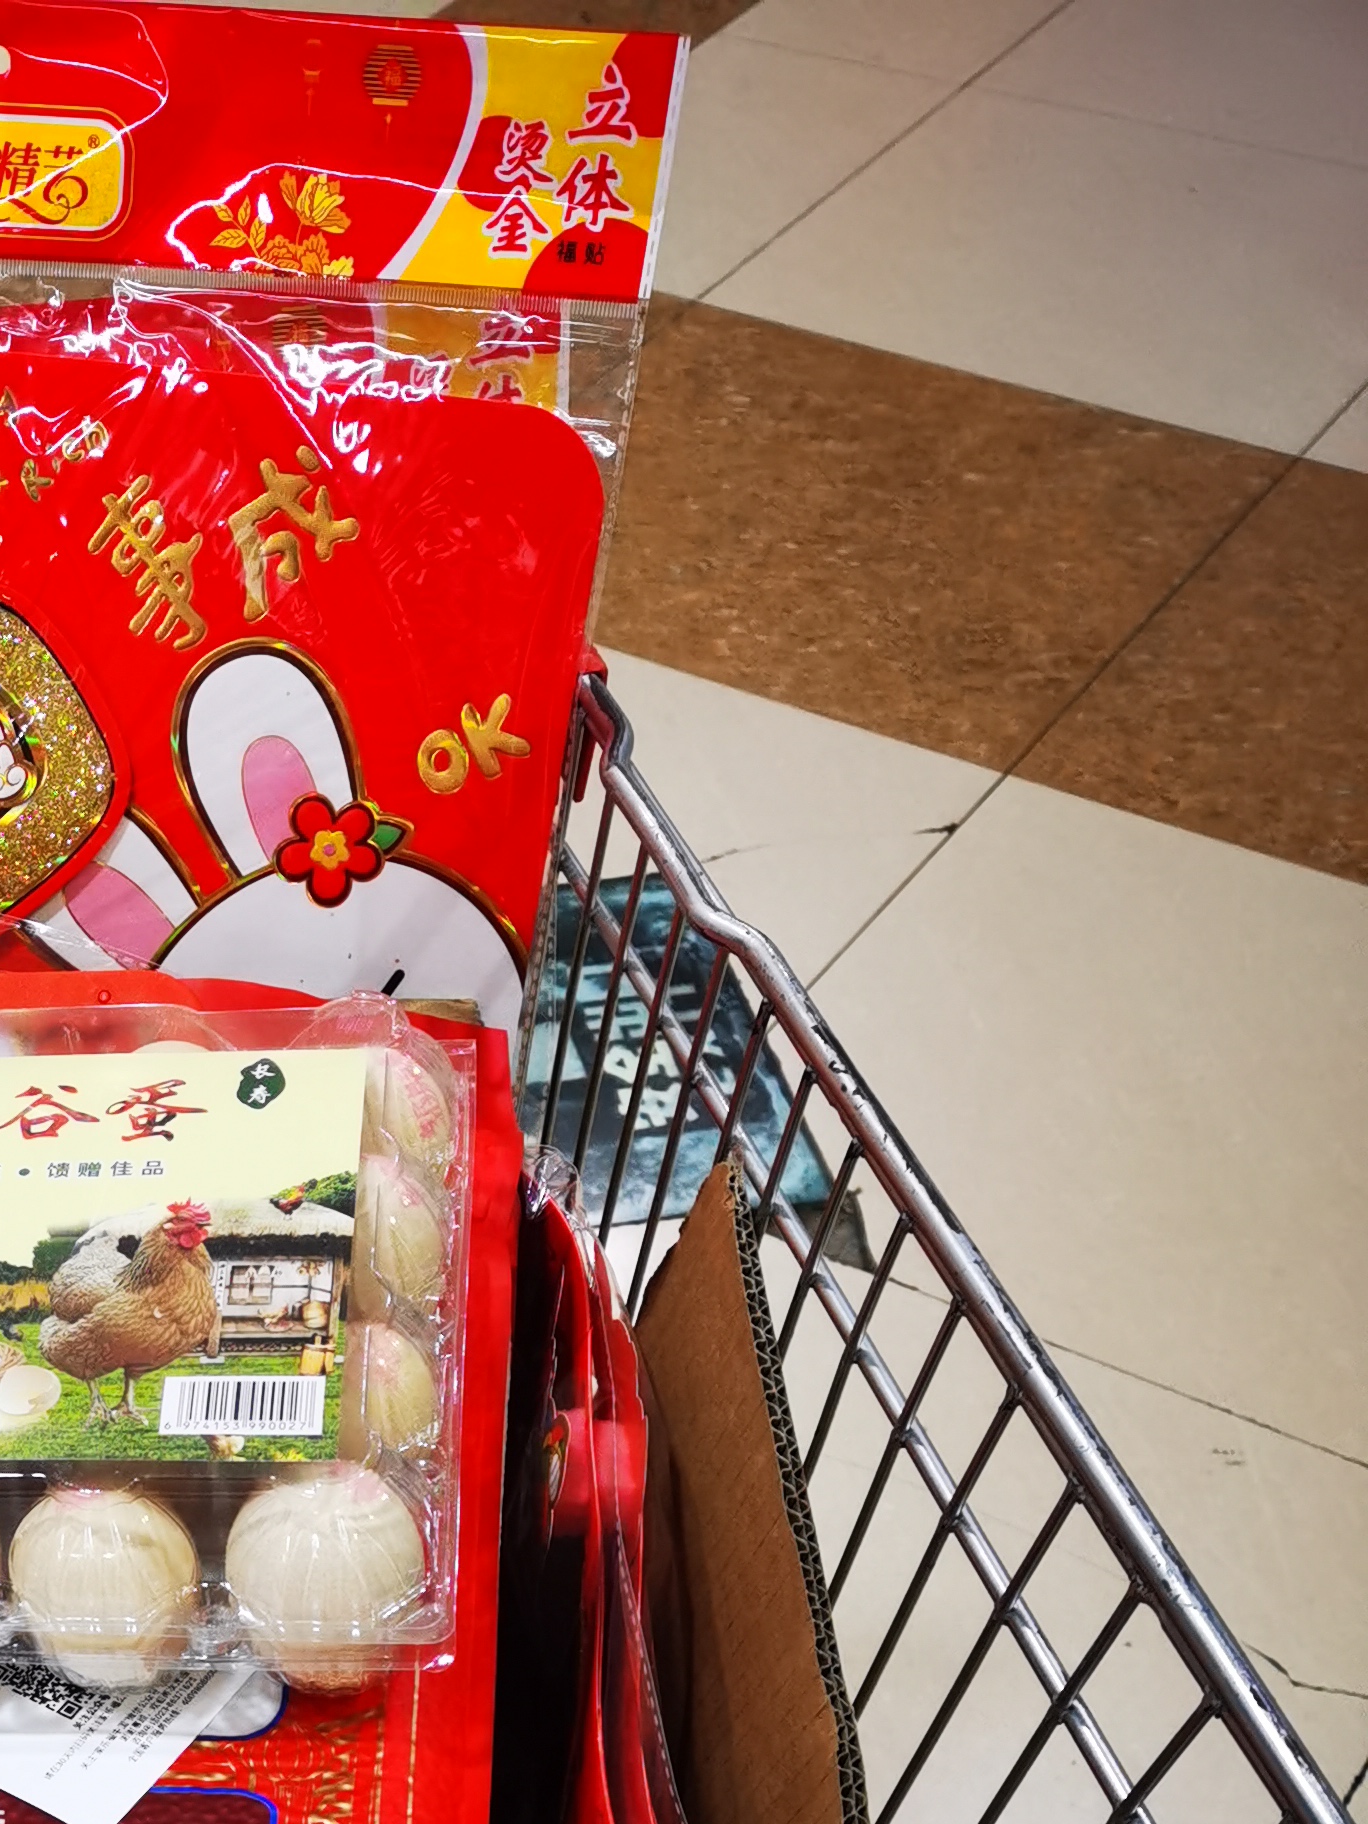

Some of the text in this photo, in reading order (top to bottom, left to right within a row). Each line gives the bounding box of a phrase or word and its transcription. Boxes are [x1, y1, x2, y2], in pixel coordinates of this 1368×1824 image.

[556, 63, 635, 228] 立体
[486, 122, 553, 254] 烫金
[557, 241, 605, 265] 福贴
[417, 694, 530, 794] OK
[248, 1063, 277, 1105] 长寿
[46, 1160, 165, 1178] 馈赠佳品
